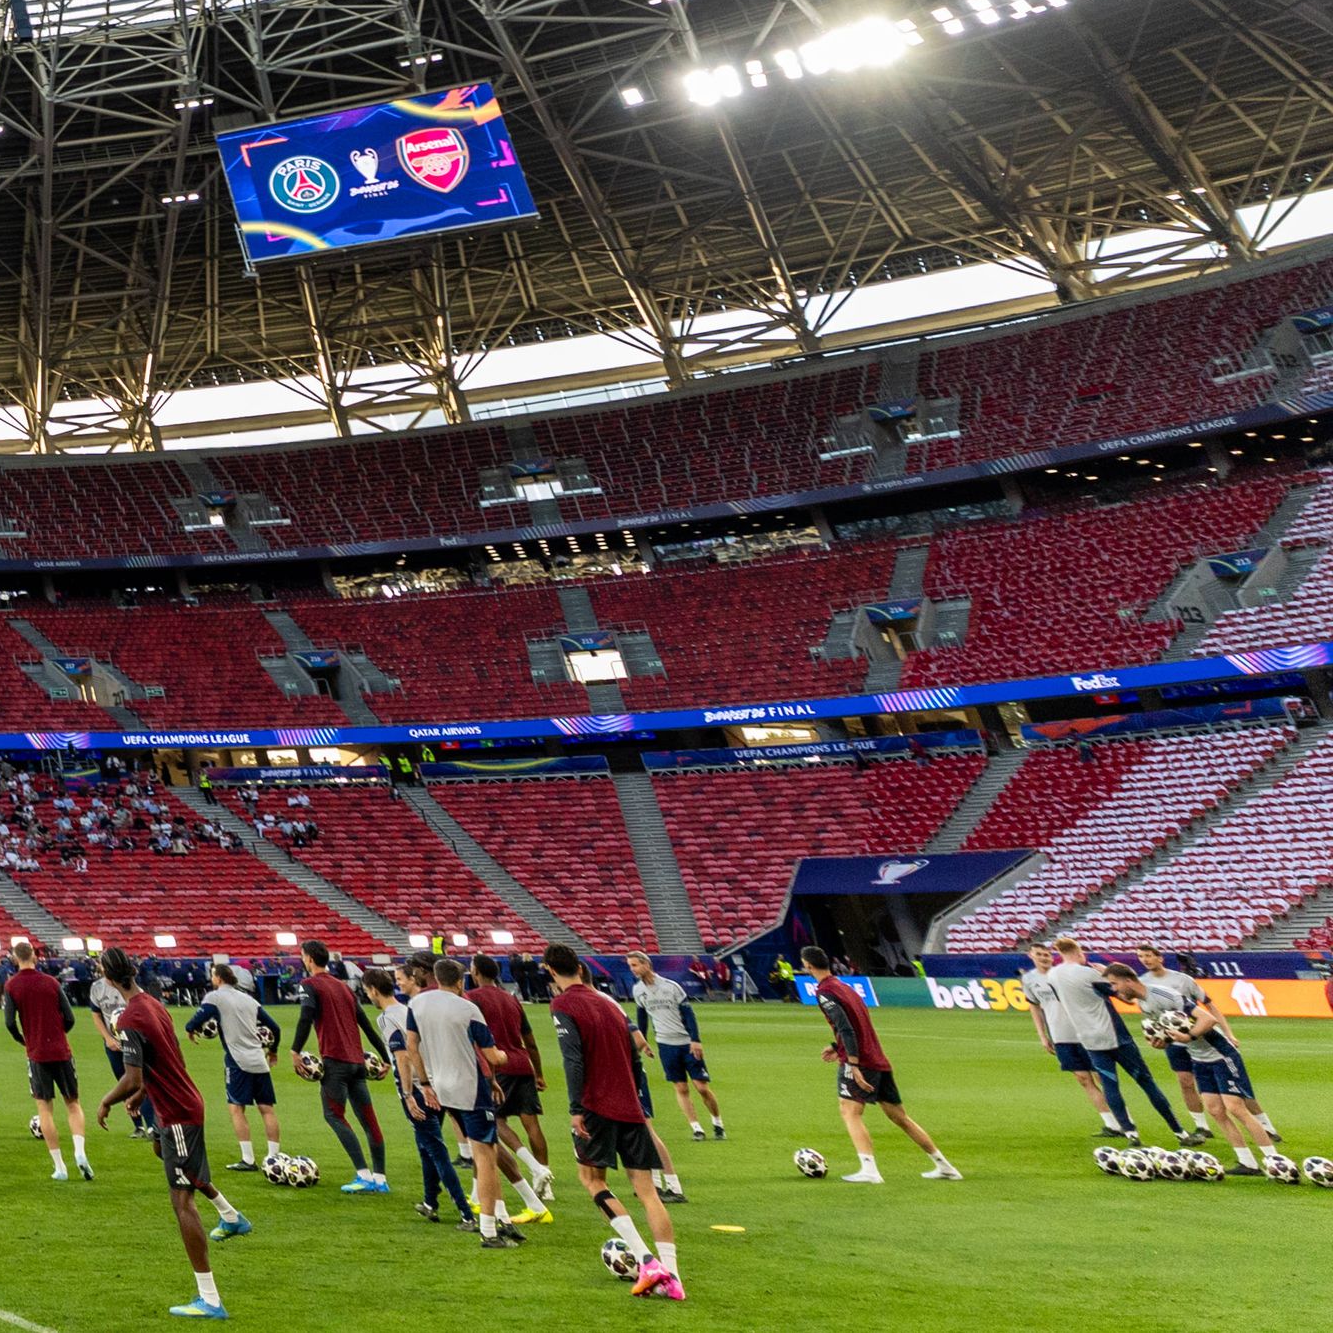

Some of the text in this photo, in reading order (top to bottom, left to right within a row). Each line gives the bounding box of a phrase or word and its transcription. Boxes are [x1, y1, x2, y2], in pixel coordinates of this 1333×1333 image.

[406, 135, 455, 154] Arsenal
[277, 159, 322, 177] PARIS
[1098, 416, 1237, 452] UEFA CHAMPIONS LEAGUE
[873, 477, 925, 490] crypto.com
[662, 512, 693, 523] FINAL
[202, 550, 299, 563] UEFA CHAMPIONS LEAGUE
[1070, 674, 1121, 692] FedEx
[768, 704, 816, 718] FINAL
[409, 725, 482, 739] QATAR AIRWAYS
[122, 733, 251, 746] UEFA CHAMPIONS LEAGUE
[734, 748, 765, 759] UEFA
[765, 744, 831, 757] CHAMPIONS
[303, 768, 334, 778] FINAL
[1210, 961, 1244, 977] 111
[925, 977, 1031, 1012] bet36
